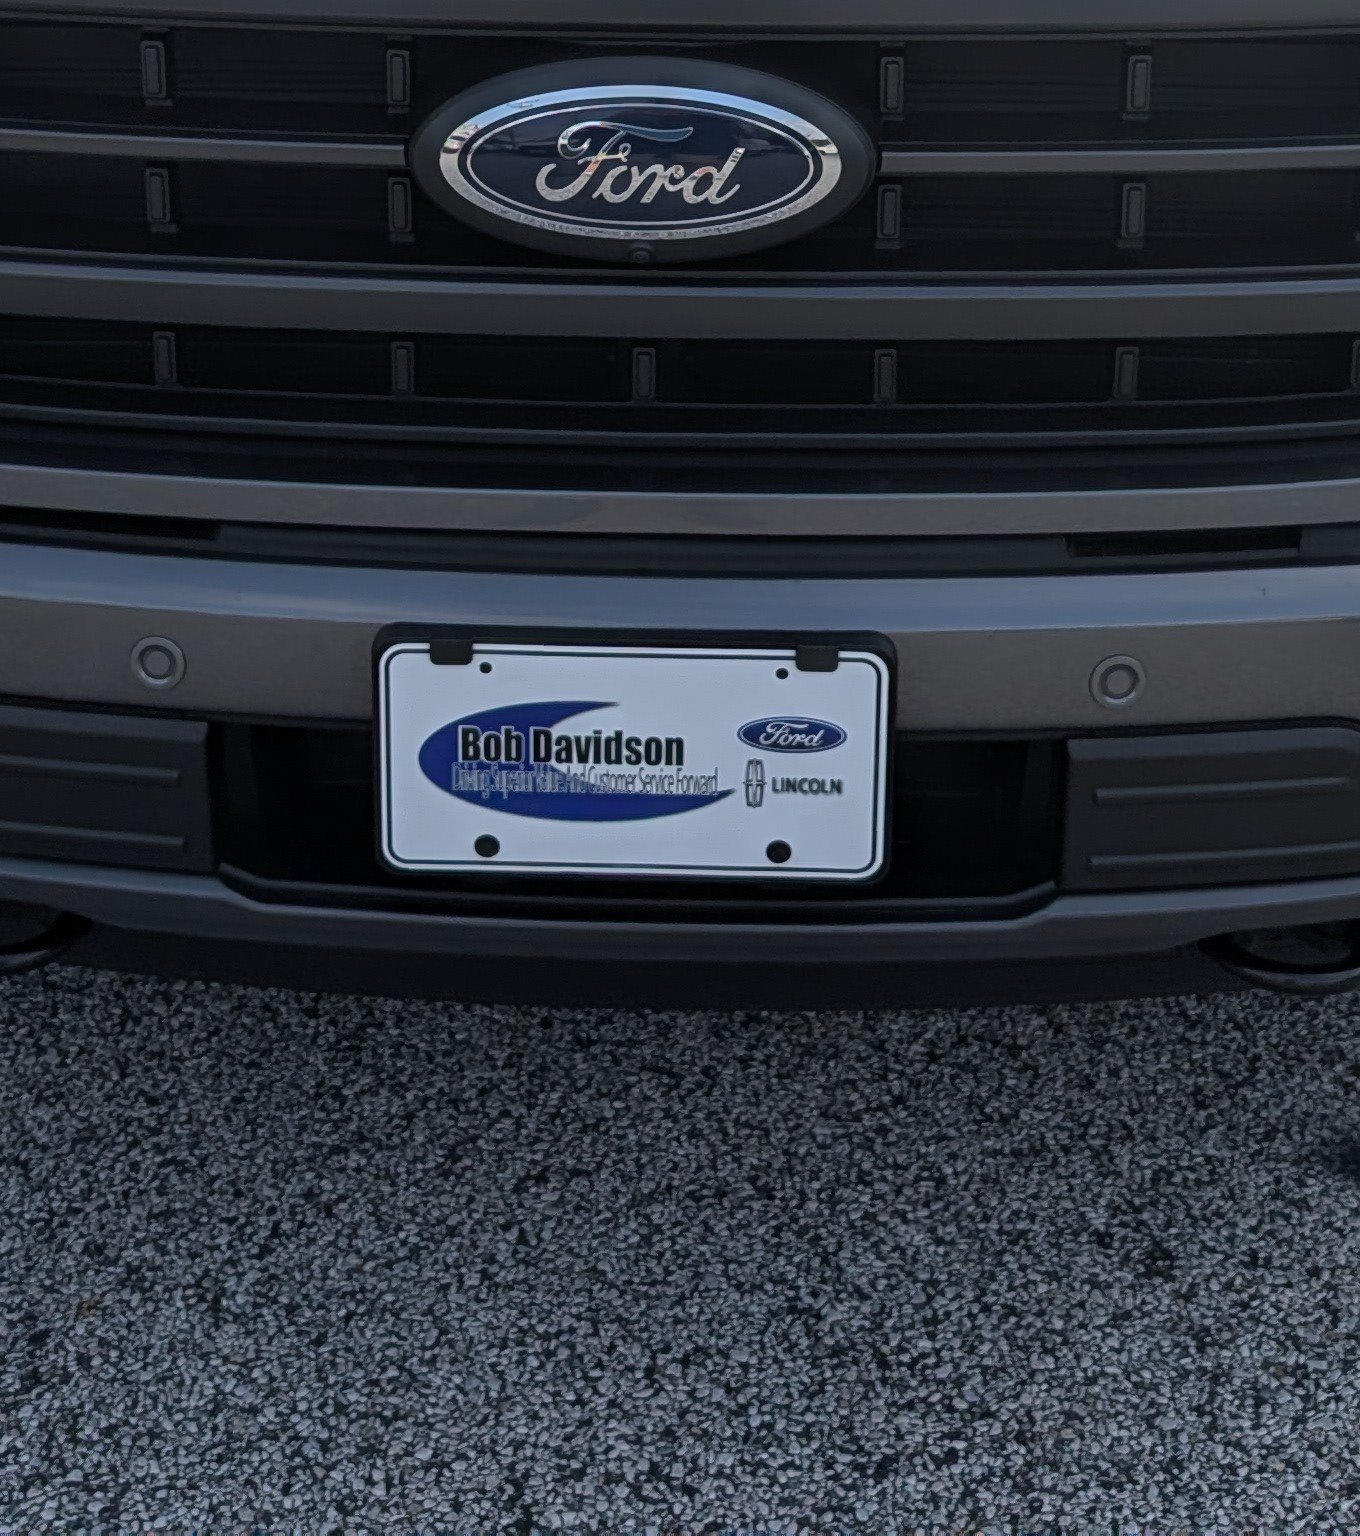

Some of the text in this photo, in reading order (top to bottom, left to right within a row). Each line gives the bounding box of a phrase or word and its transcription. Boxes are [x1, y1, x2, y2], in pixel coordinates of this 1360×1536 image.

[535, 120, 746, 205] Ford
[459, 725, 686, 767] Bob Davidson
[758, 721, 825, 747] Ford
[588, 765, 637, 794] Customer
[638, 766, 675, 795] Service
[676, 767, 719, 796] Forward
[771, 777, 843, 795] LINCOLN
